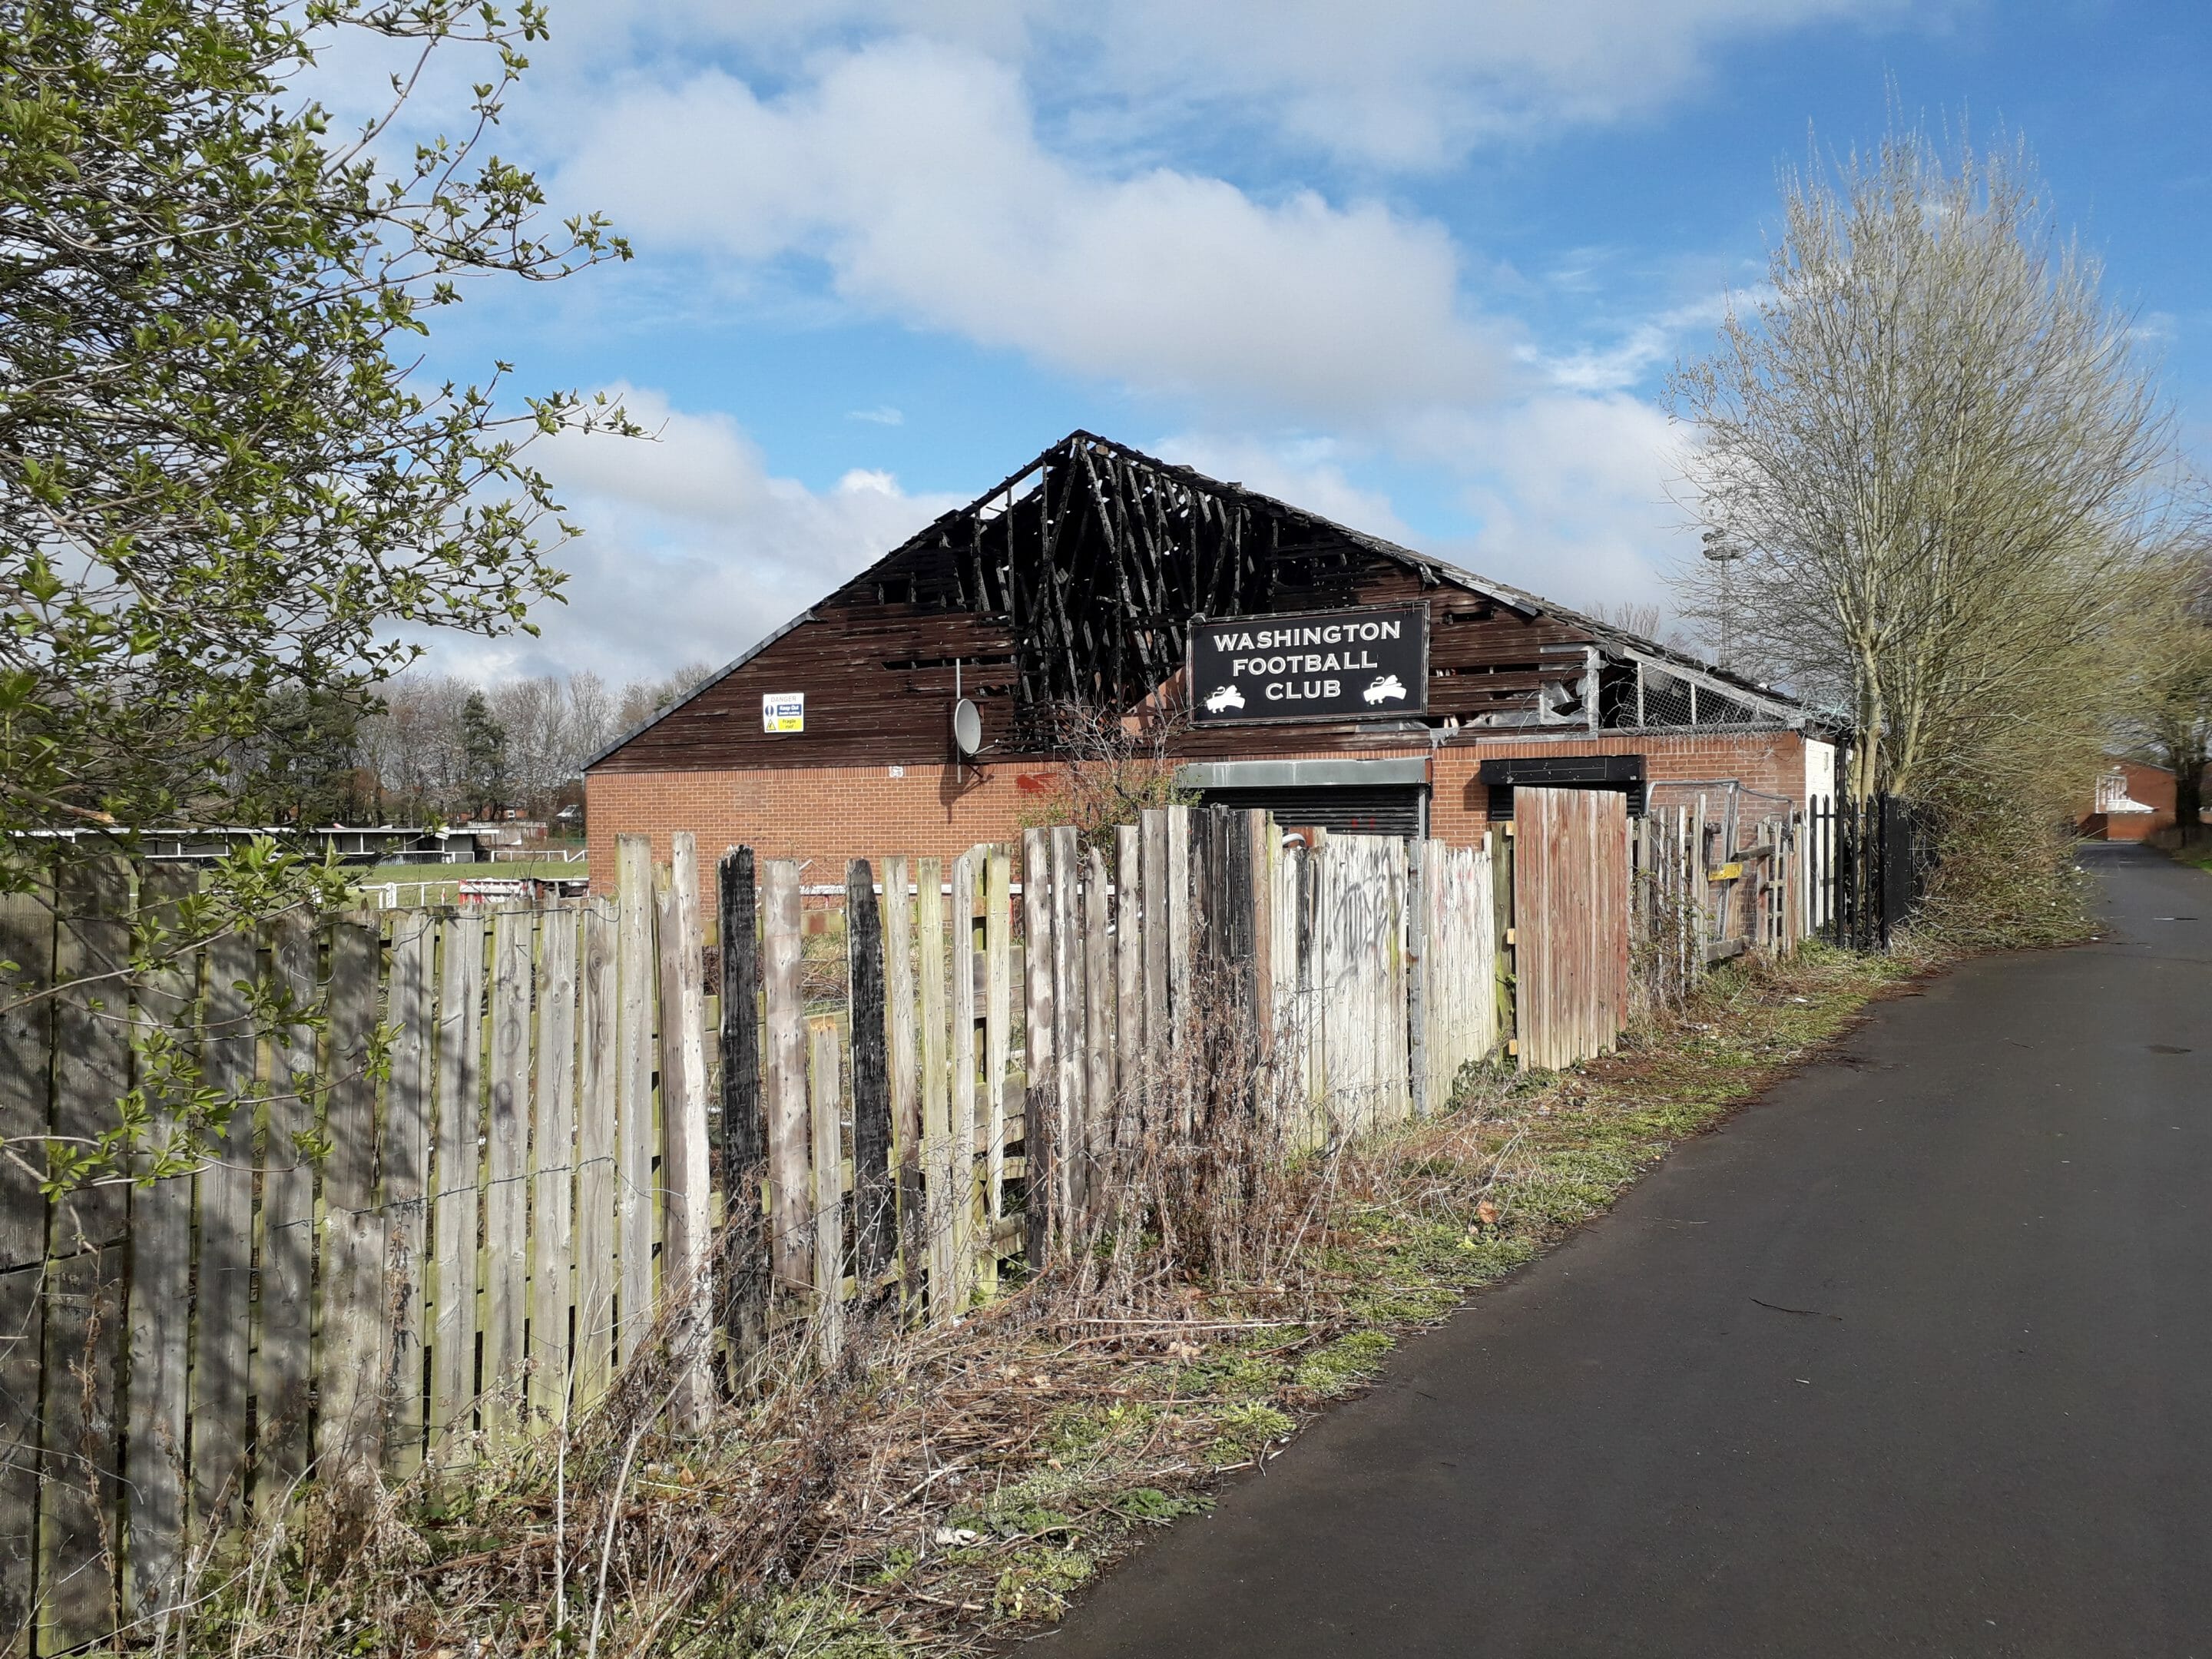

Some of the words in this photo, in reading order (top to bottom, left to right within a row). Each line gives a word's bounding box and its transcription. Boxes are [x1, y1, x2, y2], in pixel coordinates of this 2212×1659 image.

[1214, 621, 1401, 652] WASHINGTON
[1232, 651, 1378, 677] FOOTBALL
[1265, 680, 1342, 700] CLUB
